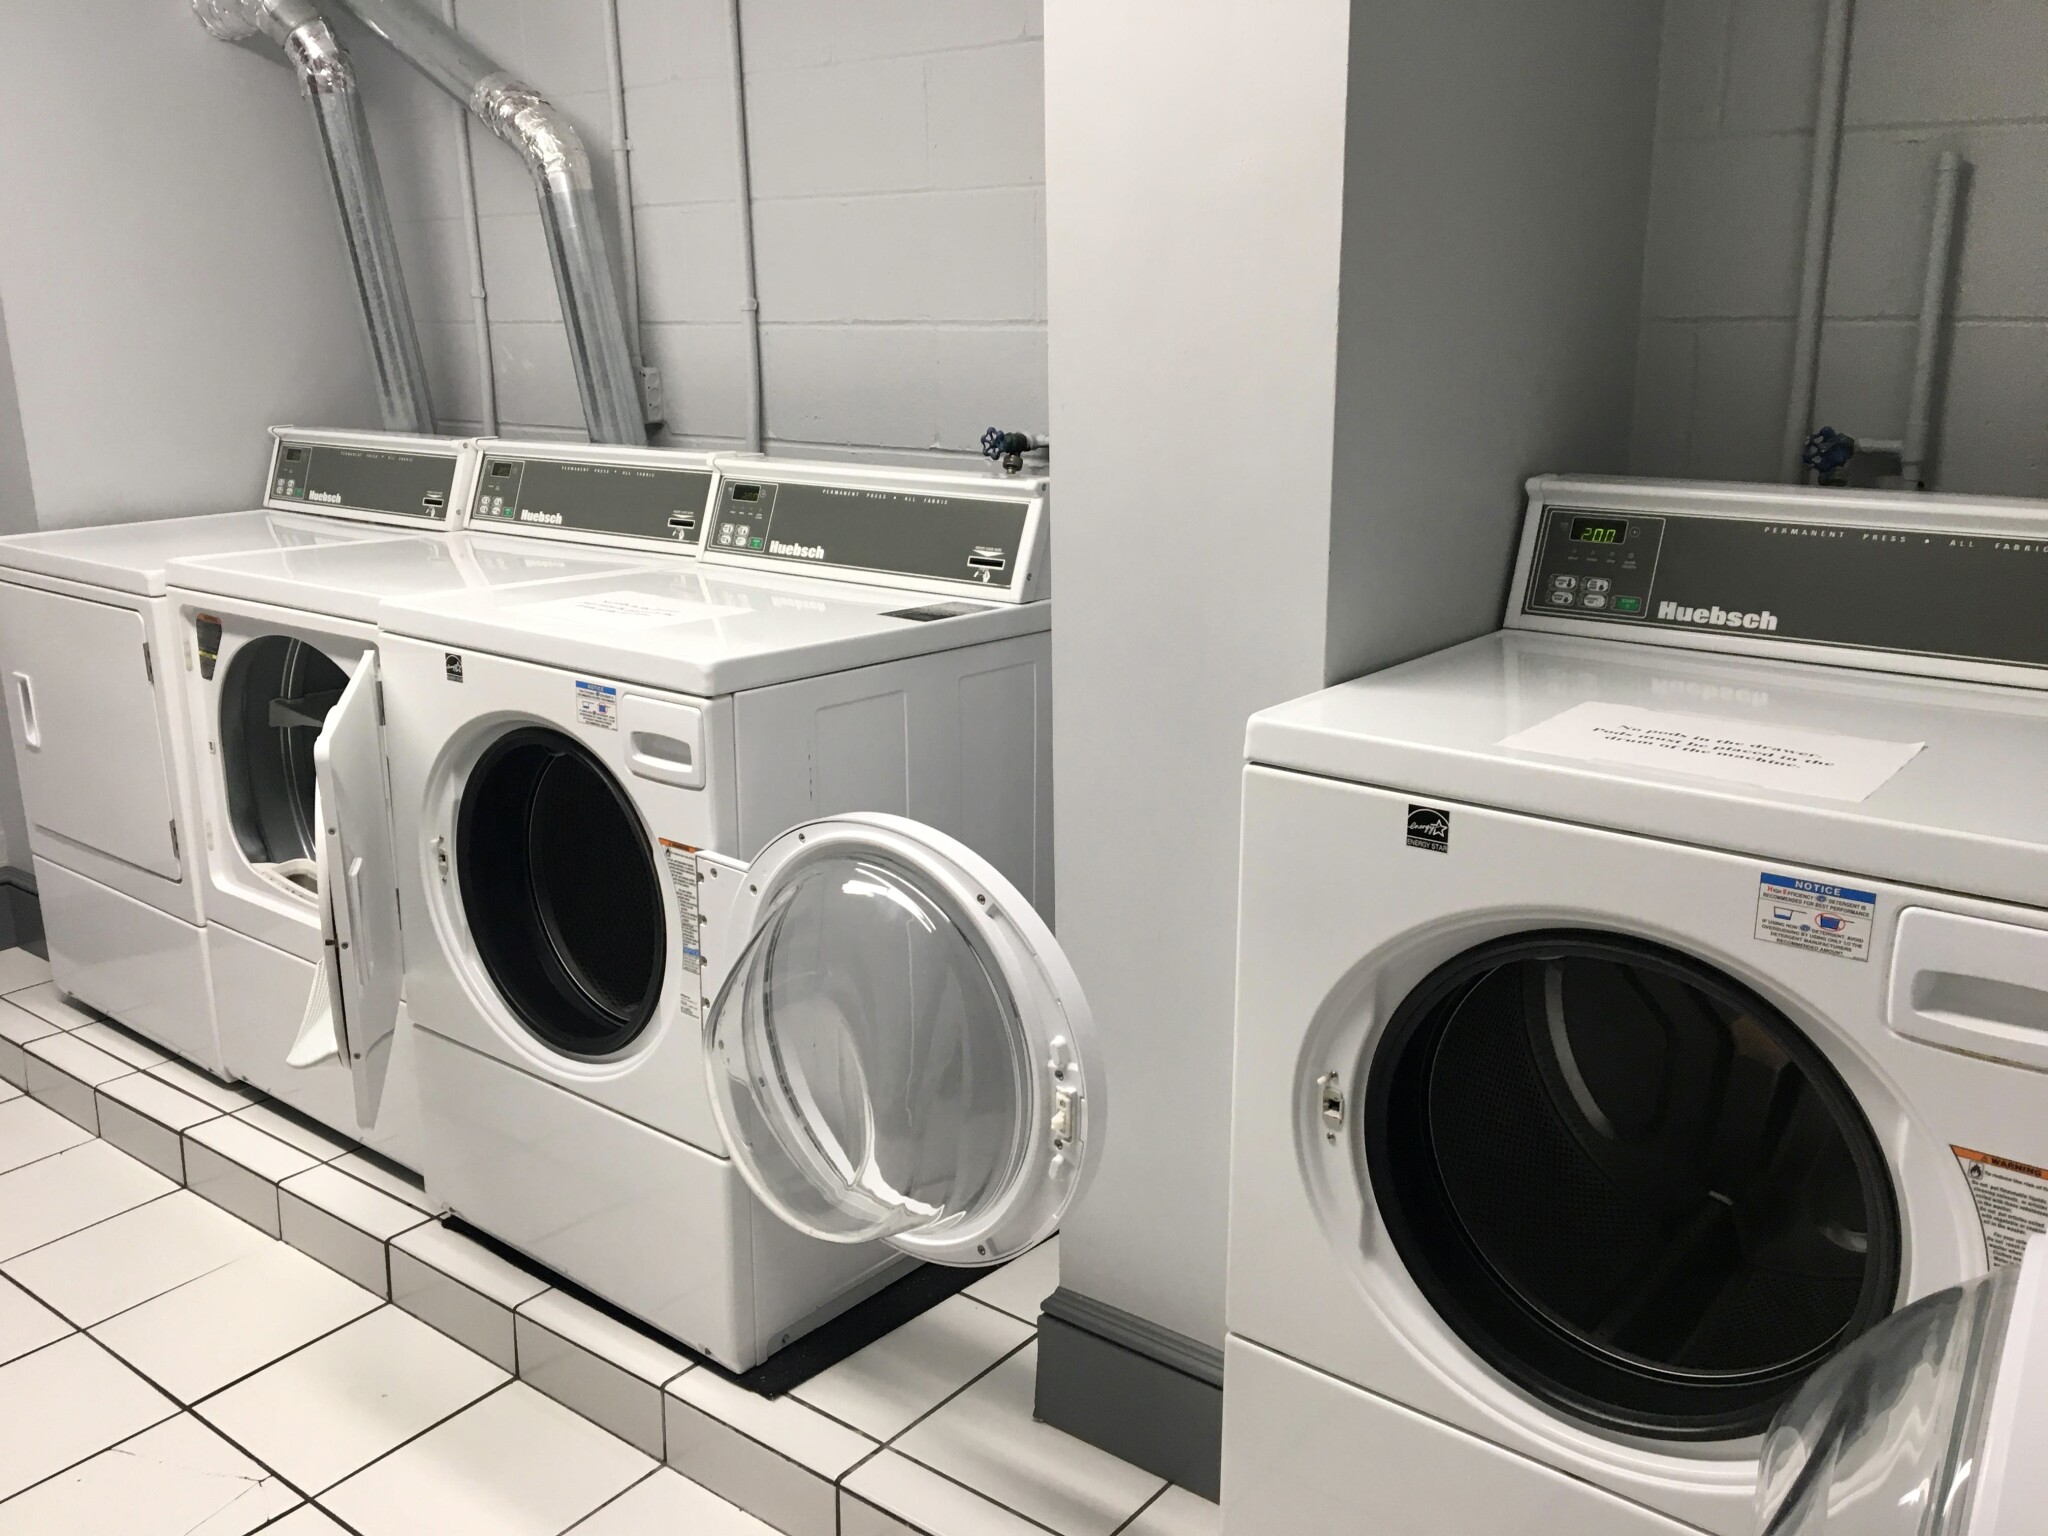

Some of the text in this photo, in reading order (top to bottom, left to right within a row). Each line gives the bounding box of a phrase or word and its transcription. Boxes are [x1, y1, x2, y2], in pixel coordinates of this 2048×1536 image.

[309, 489, 342, 504] Huebsch
[822, 488, 860, 497] PERMANENT
[866, 492, 887, 500] PRESS
[520, 508, 563, 525] Huebsch
[1764, 526, 1845, 538] PERMANENT
[1862, 533, 1907, 543] PRESS
[1949, 539, 1974, 548] ALL
[769, 540, 825, 560] Huebsch
[1657, 600, 1778, 631] Huebsch
[1593, 727, 1632, 736] Pods
[1638, 735, 1682, 744] must
[1713, 746, 1775, 757] placed
[1617, 724, 1641, 732] No
[1646, 730, 1687, 738] pods
[1749, 744, 1822, 758] drawer.
[1605, 736, 1653, 745] drum
[1716, 752, 1800, 768] machine.
[1407, 838, 1448, 851] ENERGY STAR
[1794, 880, 1841, 896] NOTICE
[1763, 892, 1803, 904] RECOMMENDED
[1830, 905, 1870, 917] PERFORMANCE
[1828, 899, 1861, 909] DETERGENT
[1991, 1157, 2042, 1177] WARNING
